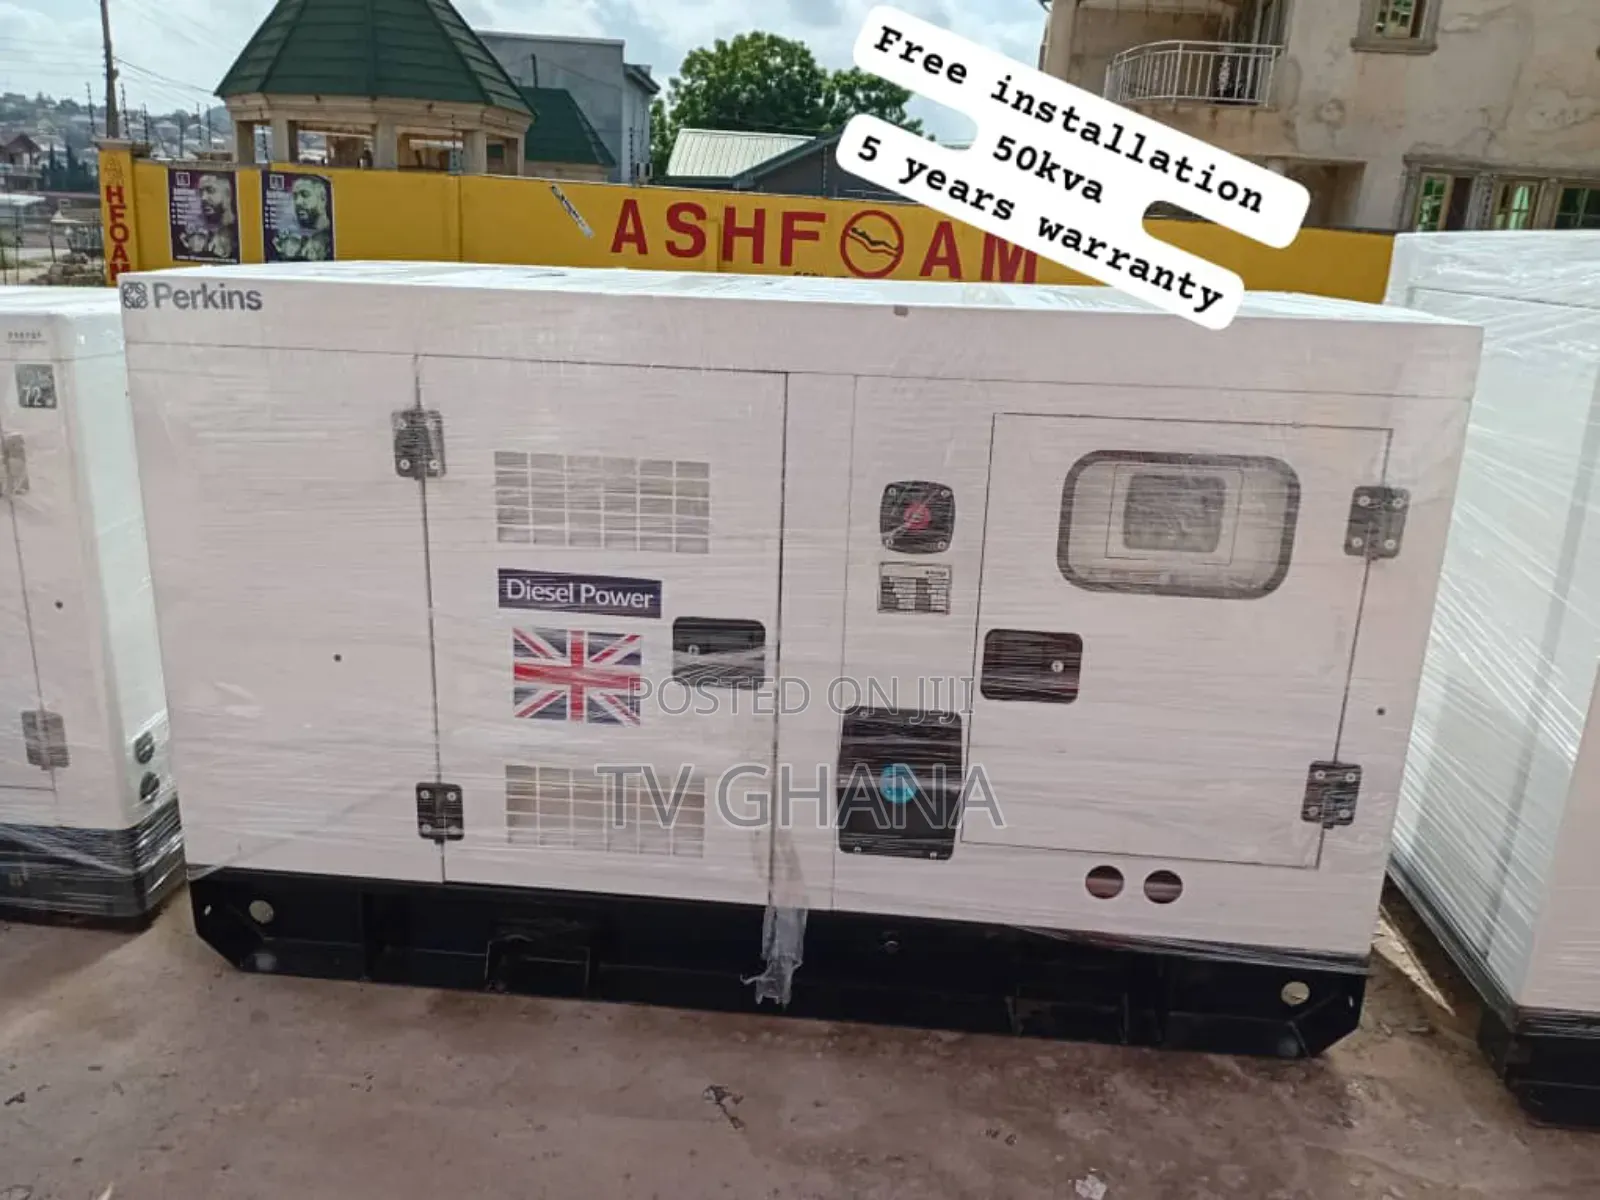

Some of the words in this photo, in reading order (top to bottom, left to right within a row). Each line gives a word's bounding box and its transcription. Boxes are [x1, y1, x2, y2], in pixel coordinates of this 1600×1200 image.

[152, 282, 263, 310] Perkins
[506, 578, 574, 603] Diesel
[580, 583, 654, 609] Power
